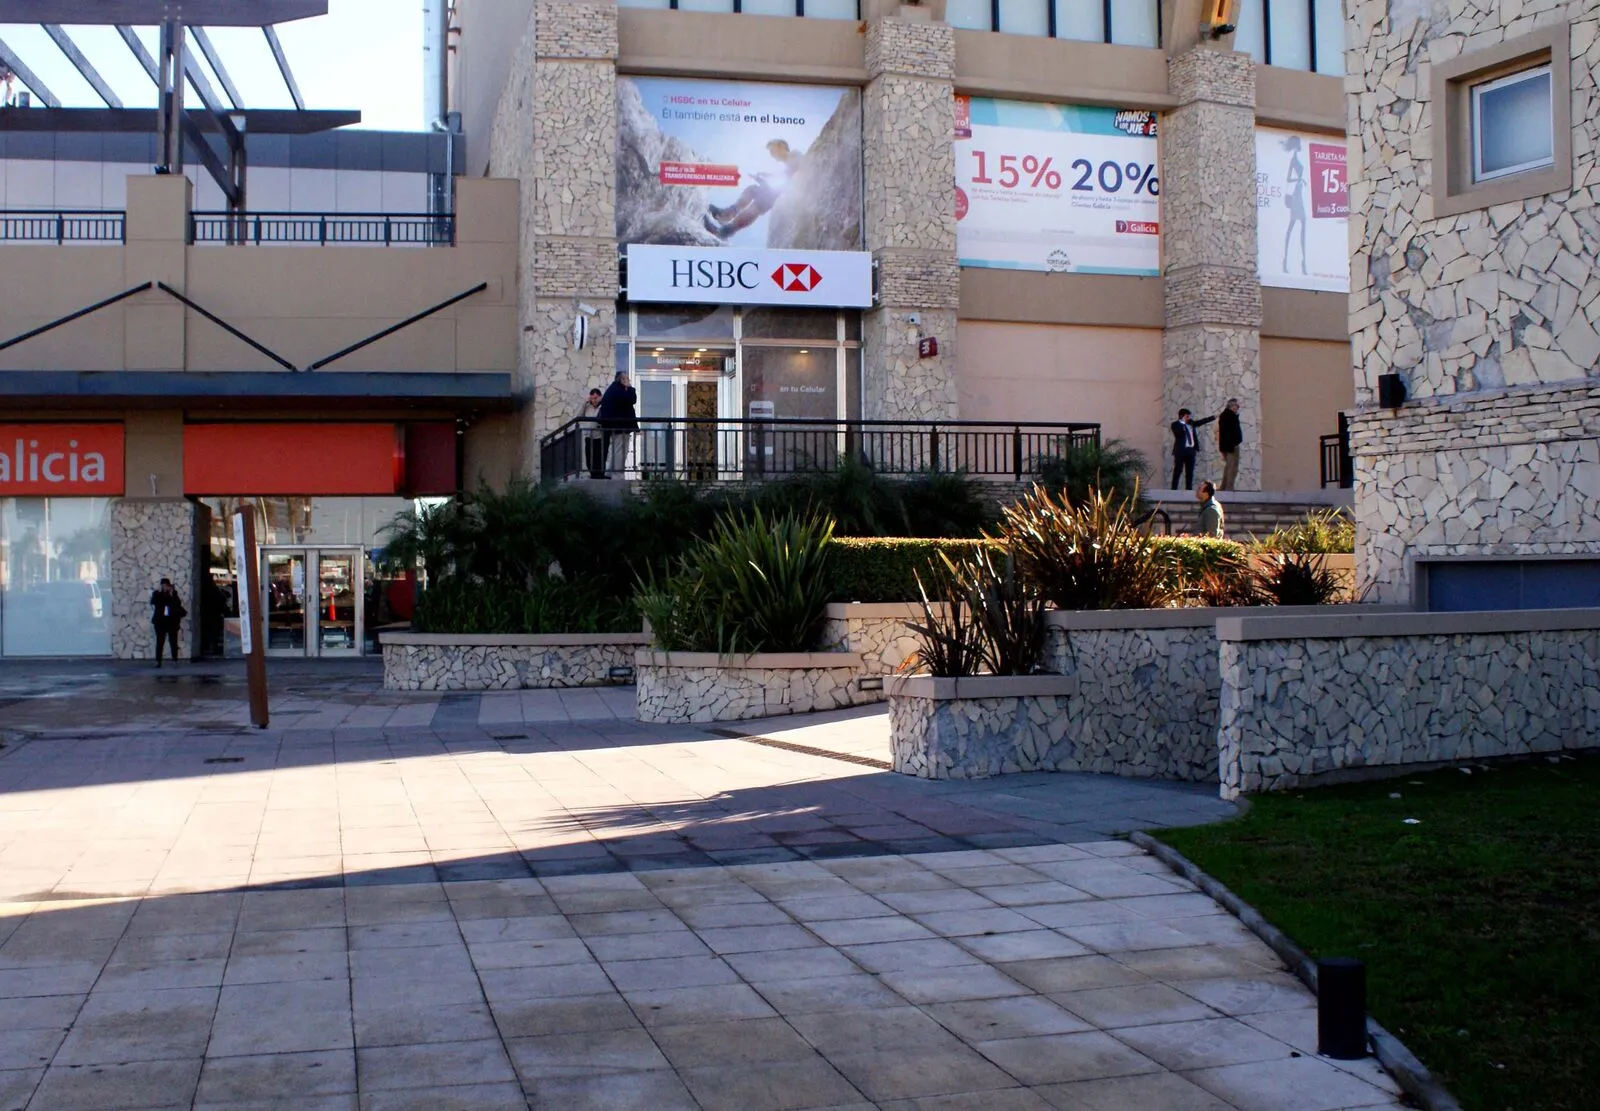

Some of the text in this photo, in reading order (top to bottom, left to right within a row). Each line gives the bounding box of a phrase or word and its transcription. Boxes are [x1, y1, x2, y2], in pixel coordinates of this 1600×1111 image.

[670, 96, 695, 105] HSBC
[710, 98, 719, 106] tu
[721, 98, 752, 107] Celular
[675, 109, 716, 121] también
[719, 111, 741, 122] está
[743, 114, 757, 123] en
[760, 113, 770, 123] el
[773, 114, 806, 126] banco
[1314, 151, 1338, 161] TARJETA
[971, 150, 1062, 190] 15%
[1071, 158, 1160, 196] 20%
[1130, 223, 1157, 233] Galicia
[670, 259, 761, 289] HSBC
[791, 385, 799, 393] tu
[800, 384, 826, 393] Celular
